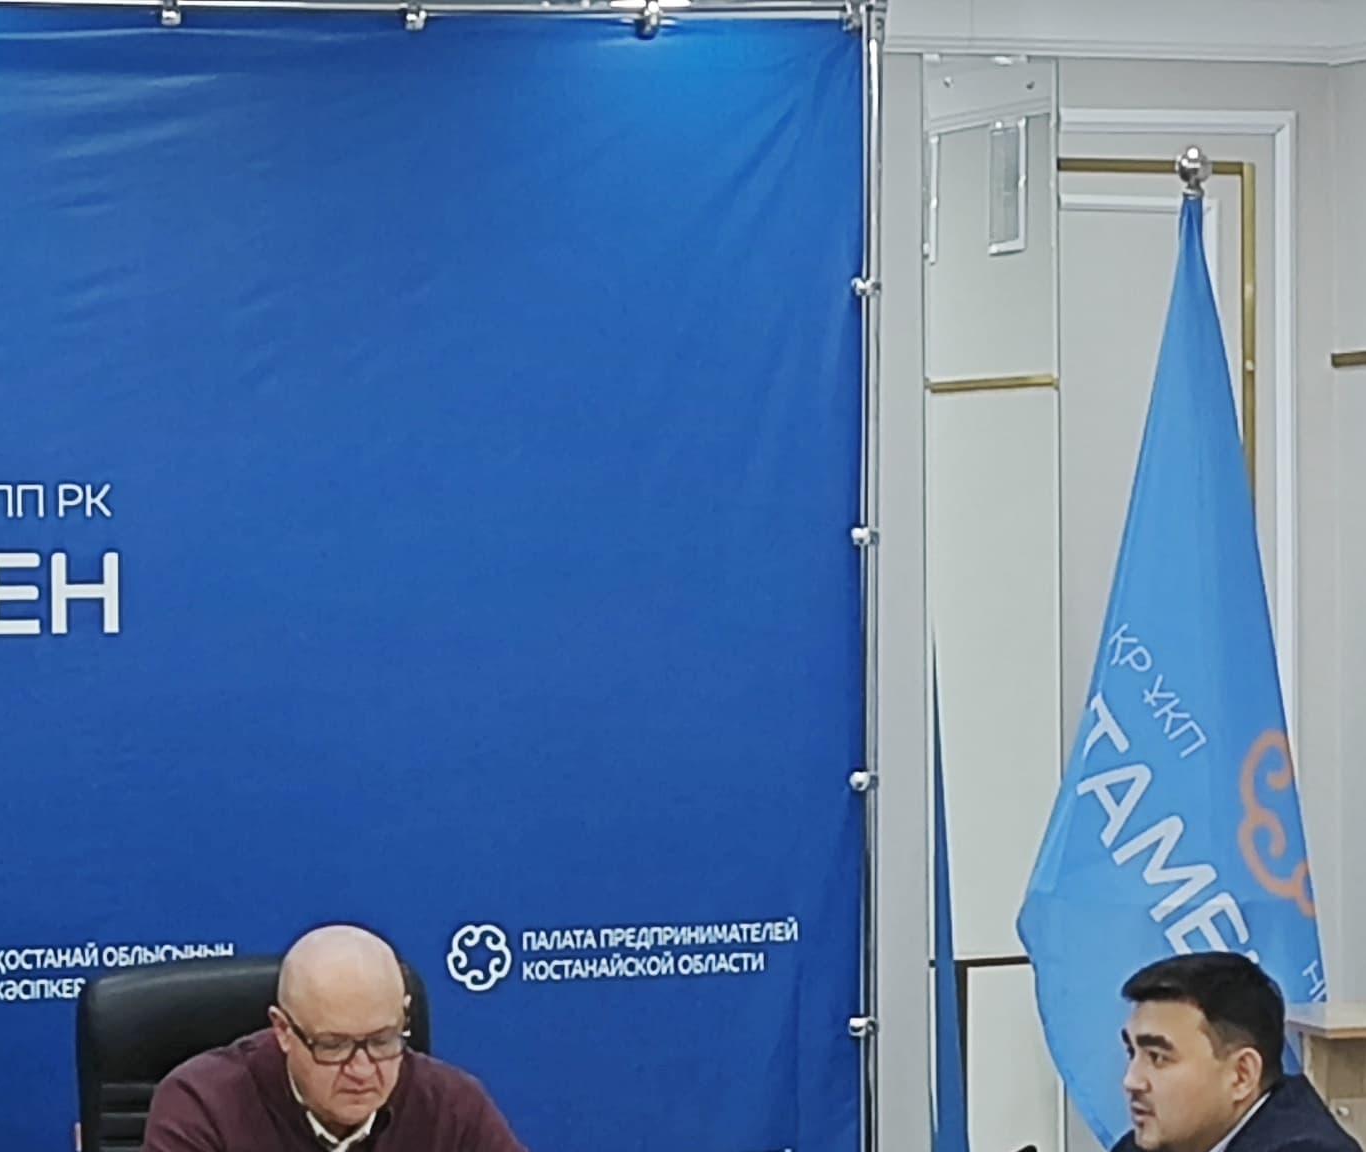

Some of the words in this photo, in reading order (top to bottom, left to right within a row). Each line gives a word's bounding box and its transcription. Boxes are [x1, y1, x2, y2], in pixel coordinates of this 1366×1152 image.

[58, 482, 113, 518] РК
[1076, 692, 1259, 964] ТАМЕ
[522, 928, 597, 951] ПАЛАТА
[600, 916, 799, 951] ПРЕДПРИНИМАТЕЛЕЙ
[522, 951, 676, 981] КОСТАНАЙСКОЙ
[677, 952, 765, 975] ОБЛАСТИ
